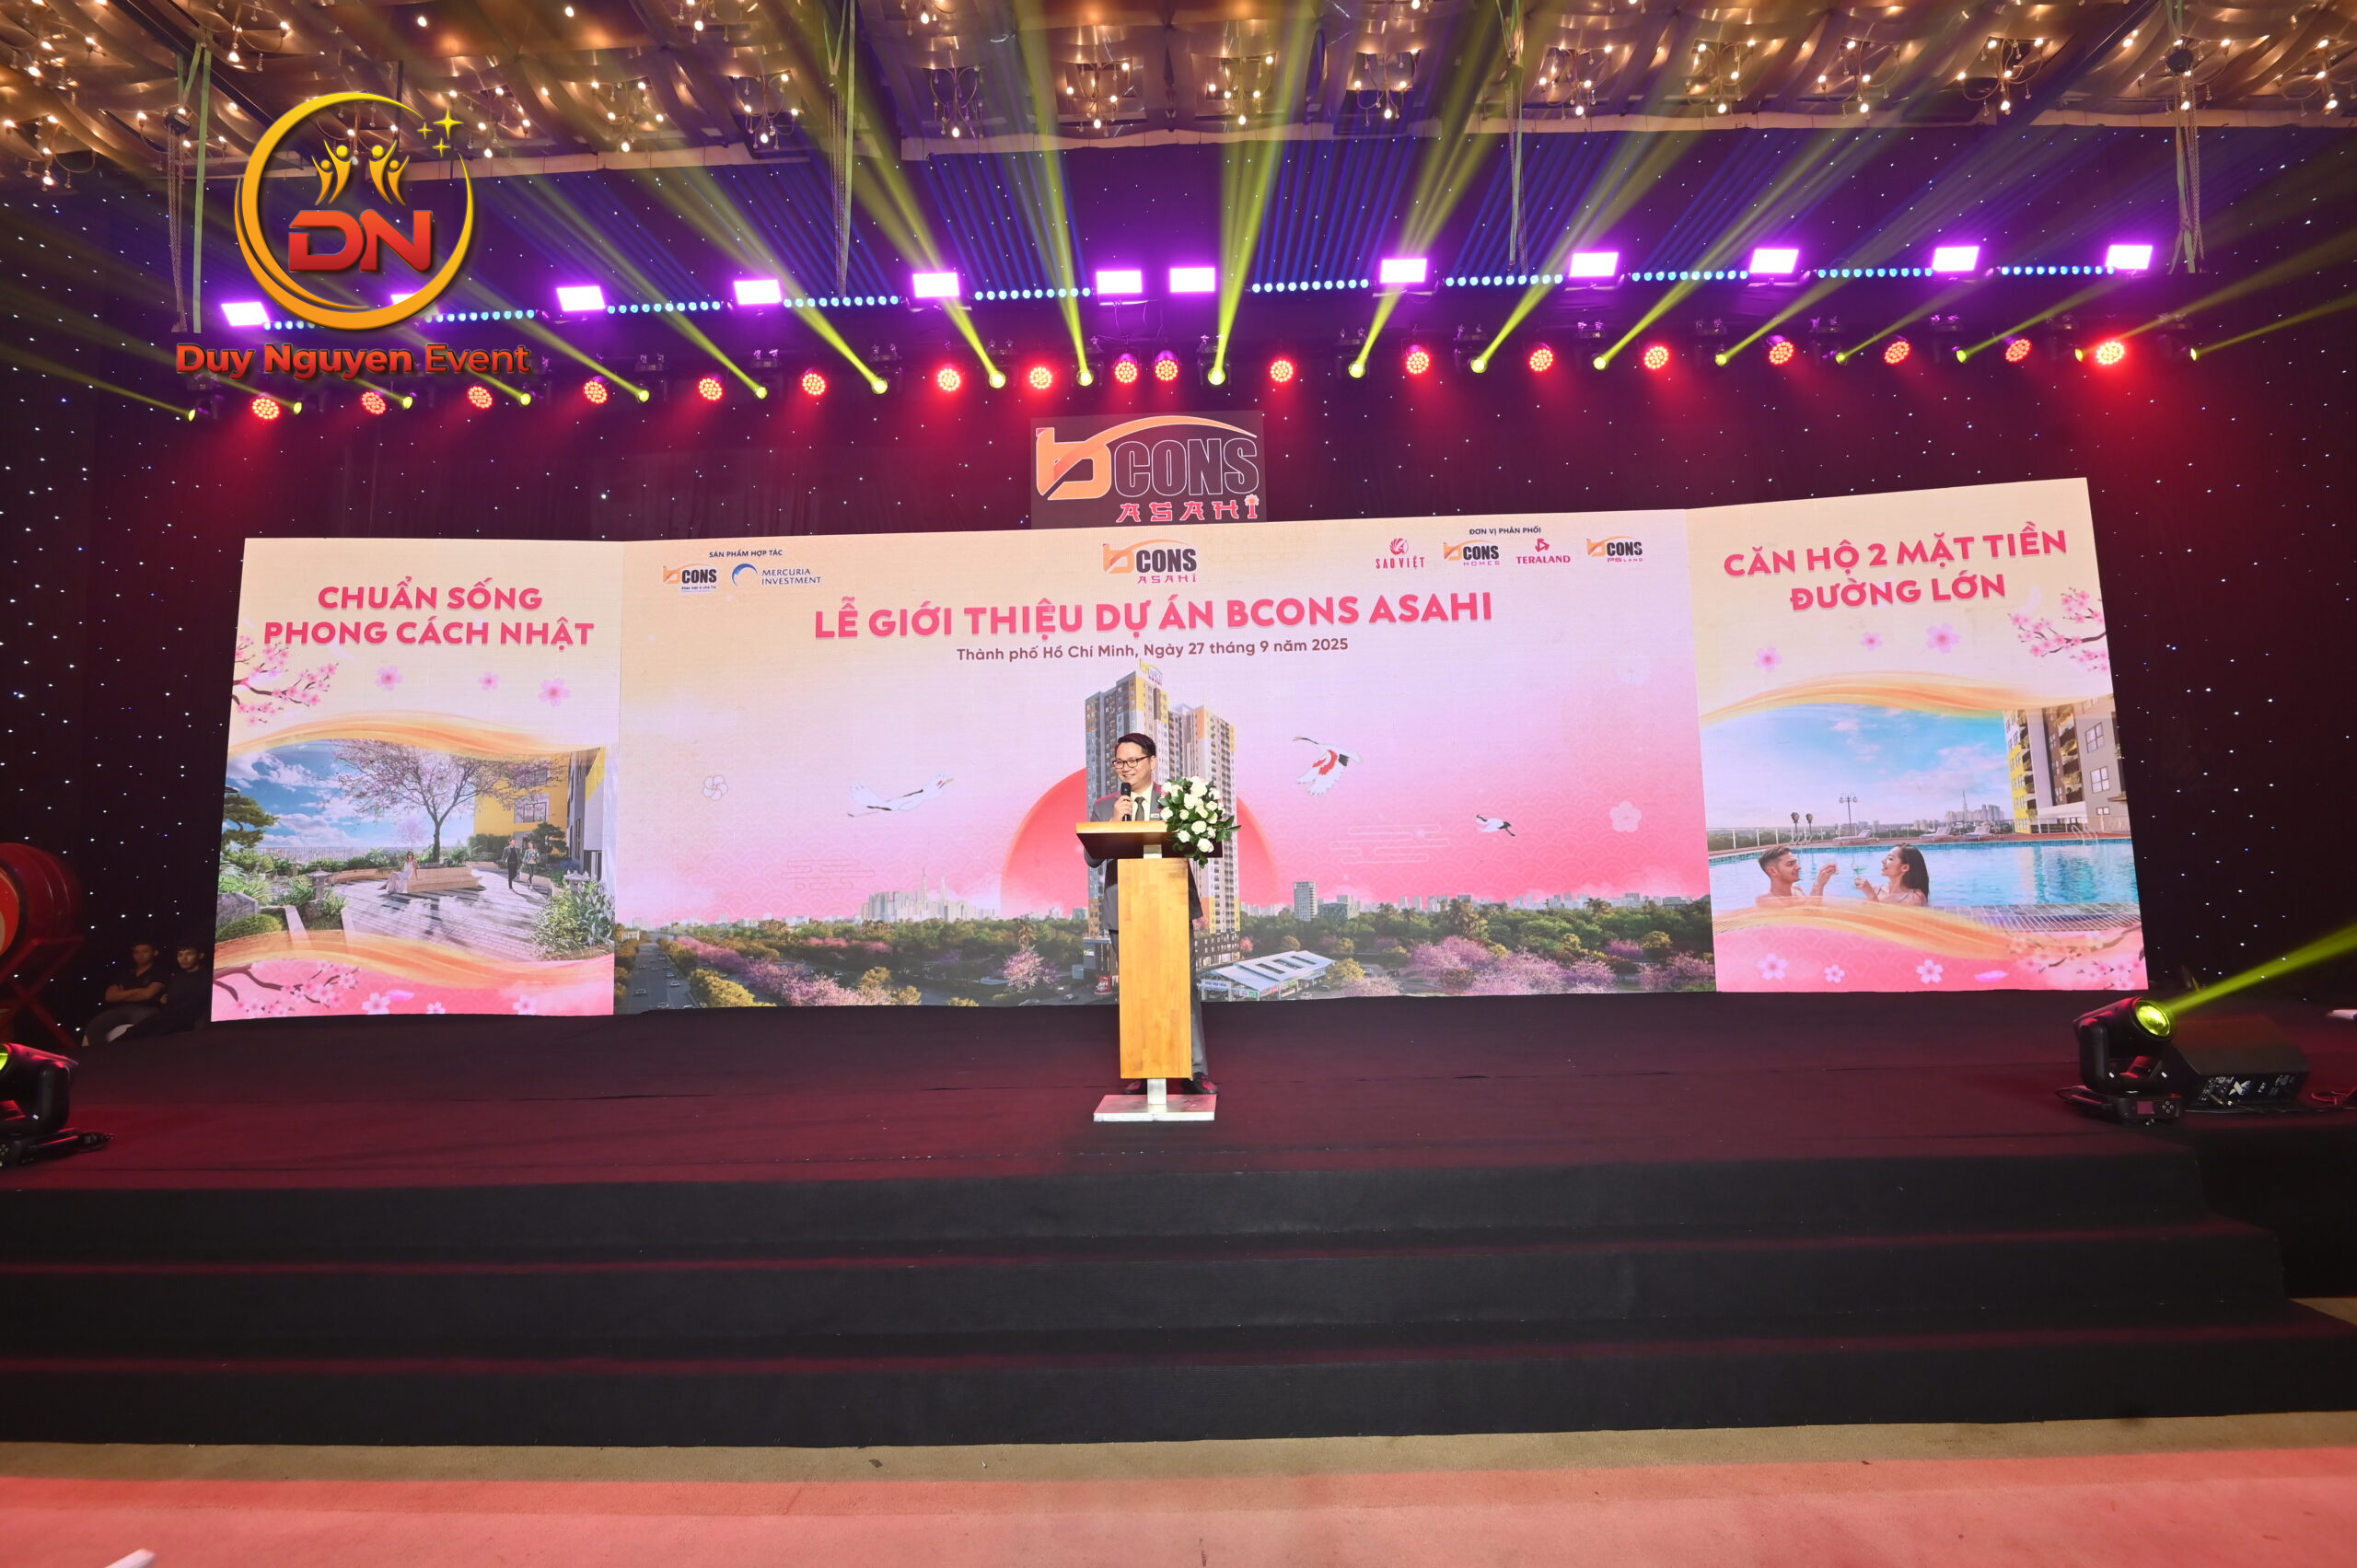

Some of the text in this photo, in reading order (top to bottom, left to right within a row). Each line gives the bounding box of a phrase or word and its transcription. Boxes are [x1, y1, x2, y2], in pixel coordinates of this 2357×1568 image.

[1516, 555, 1571, 564] TERALAND
[1724, 521, 2067, 576] CĂN HỘ 2 MẶT TIỀN
[761, 576, 821, 586] INVESTMENT
[762, 568, 811, 577] MERCURIA
[1790, 569, 2005, 610] ĐƯỜNG LỚN
[318, 575, 542, 610] CHUẨN SỐNG
[264, 616, 595, 651] PHONG CÁCH NHẬT
[816, 592, 1492, 641] LỄ GIỚI THIỆU DỰ ÁN BCONS ASAHI
[957, 638, 1349, 662] Thành phố Hồ Chí Minh, Ngày 27 tháng 9 năm 2025
